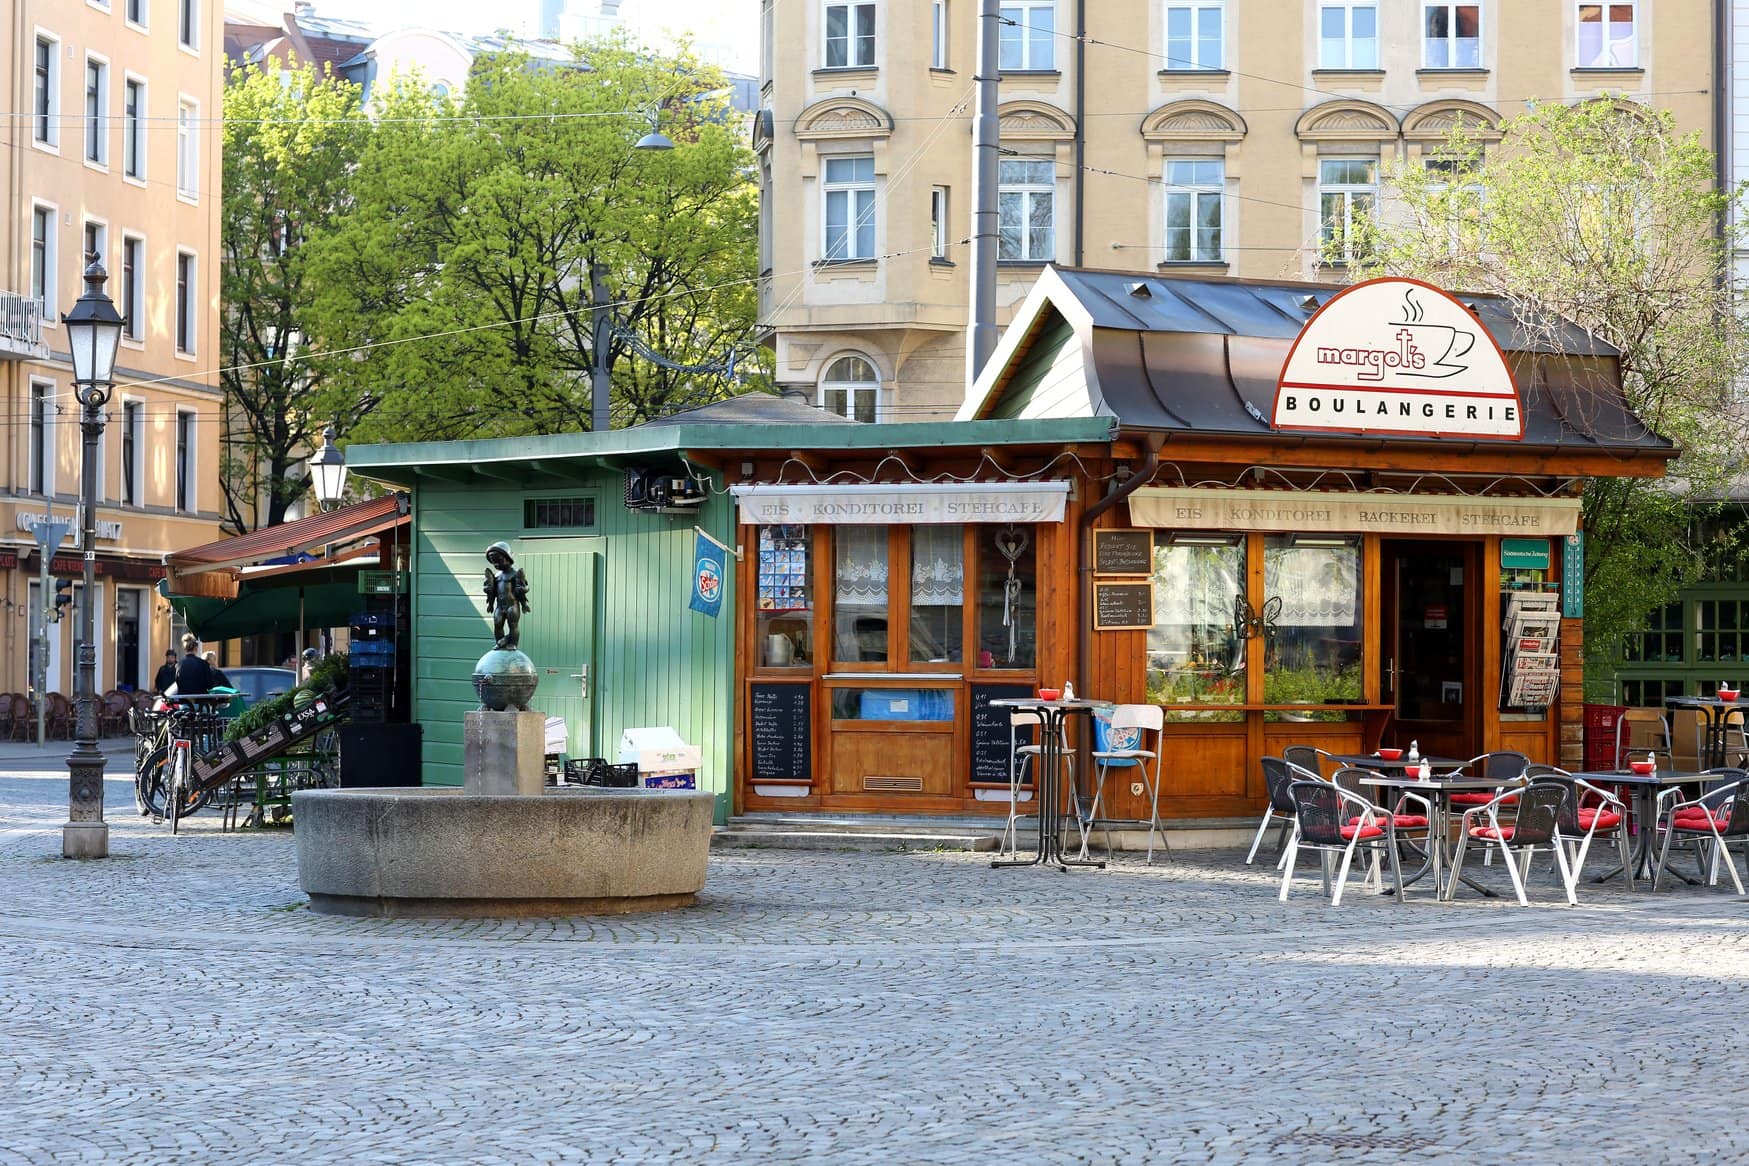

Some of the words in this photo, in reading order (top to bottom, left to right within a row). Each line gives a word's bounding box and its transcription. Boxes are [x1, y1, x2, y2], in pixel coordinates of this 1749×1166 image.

[1317, 328, 1425, 381] margot's
[1285, 396, 1515, 421] BOULANGERIE
[761, 504, 790, 516] EIS
[812, 503, 924, 516] KONDITOREI
[1175, 507, 1202, 519] EIS
[1230, 508, 1332, 521] KONDITOREI
